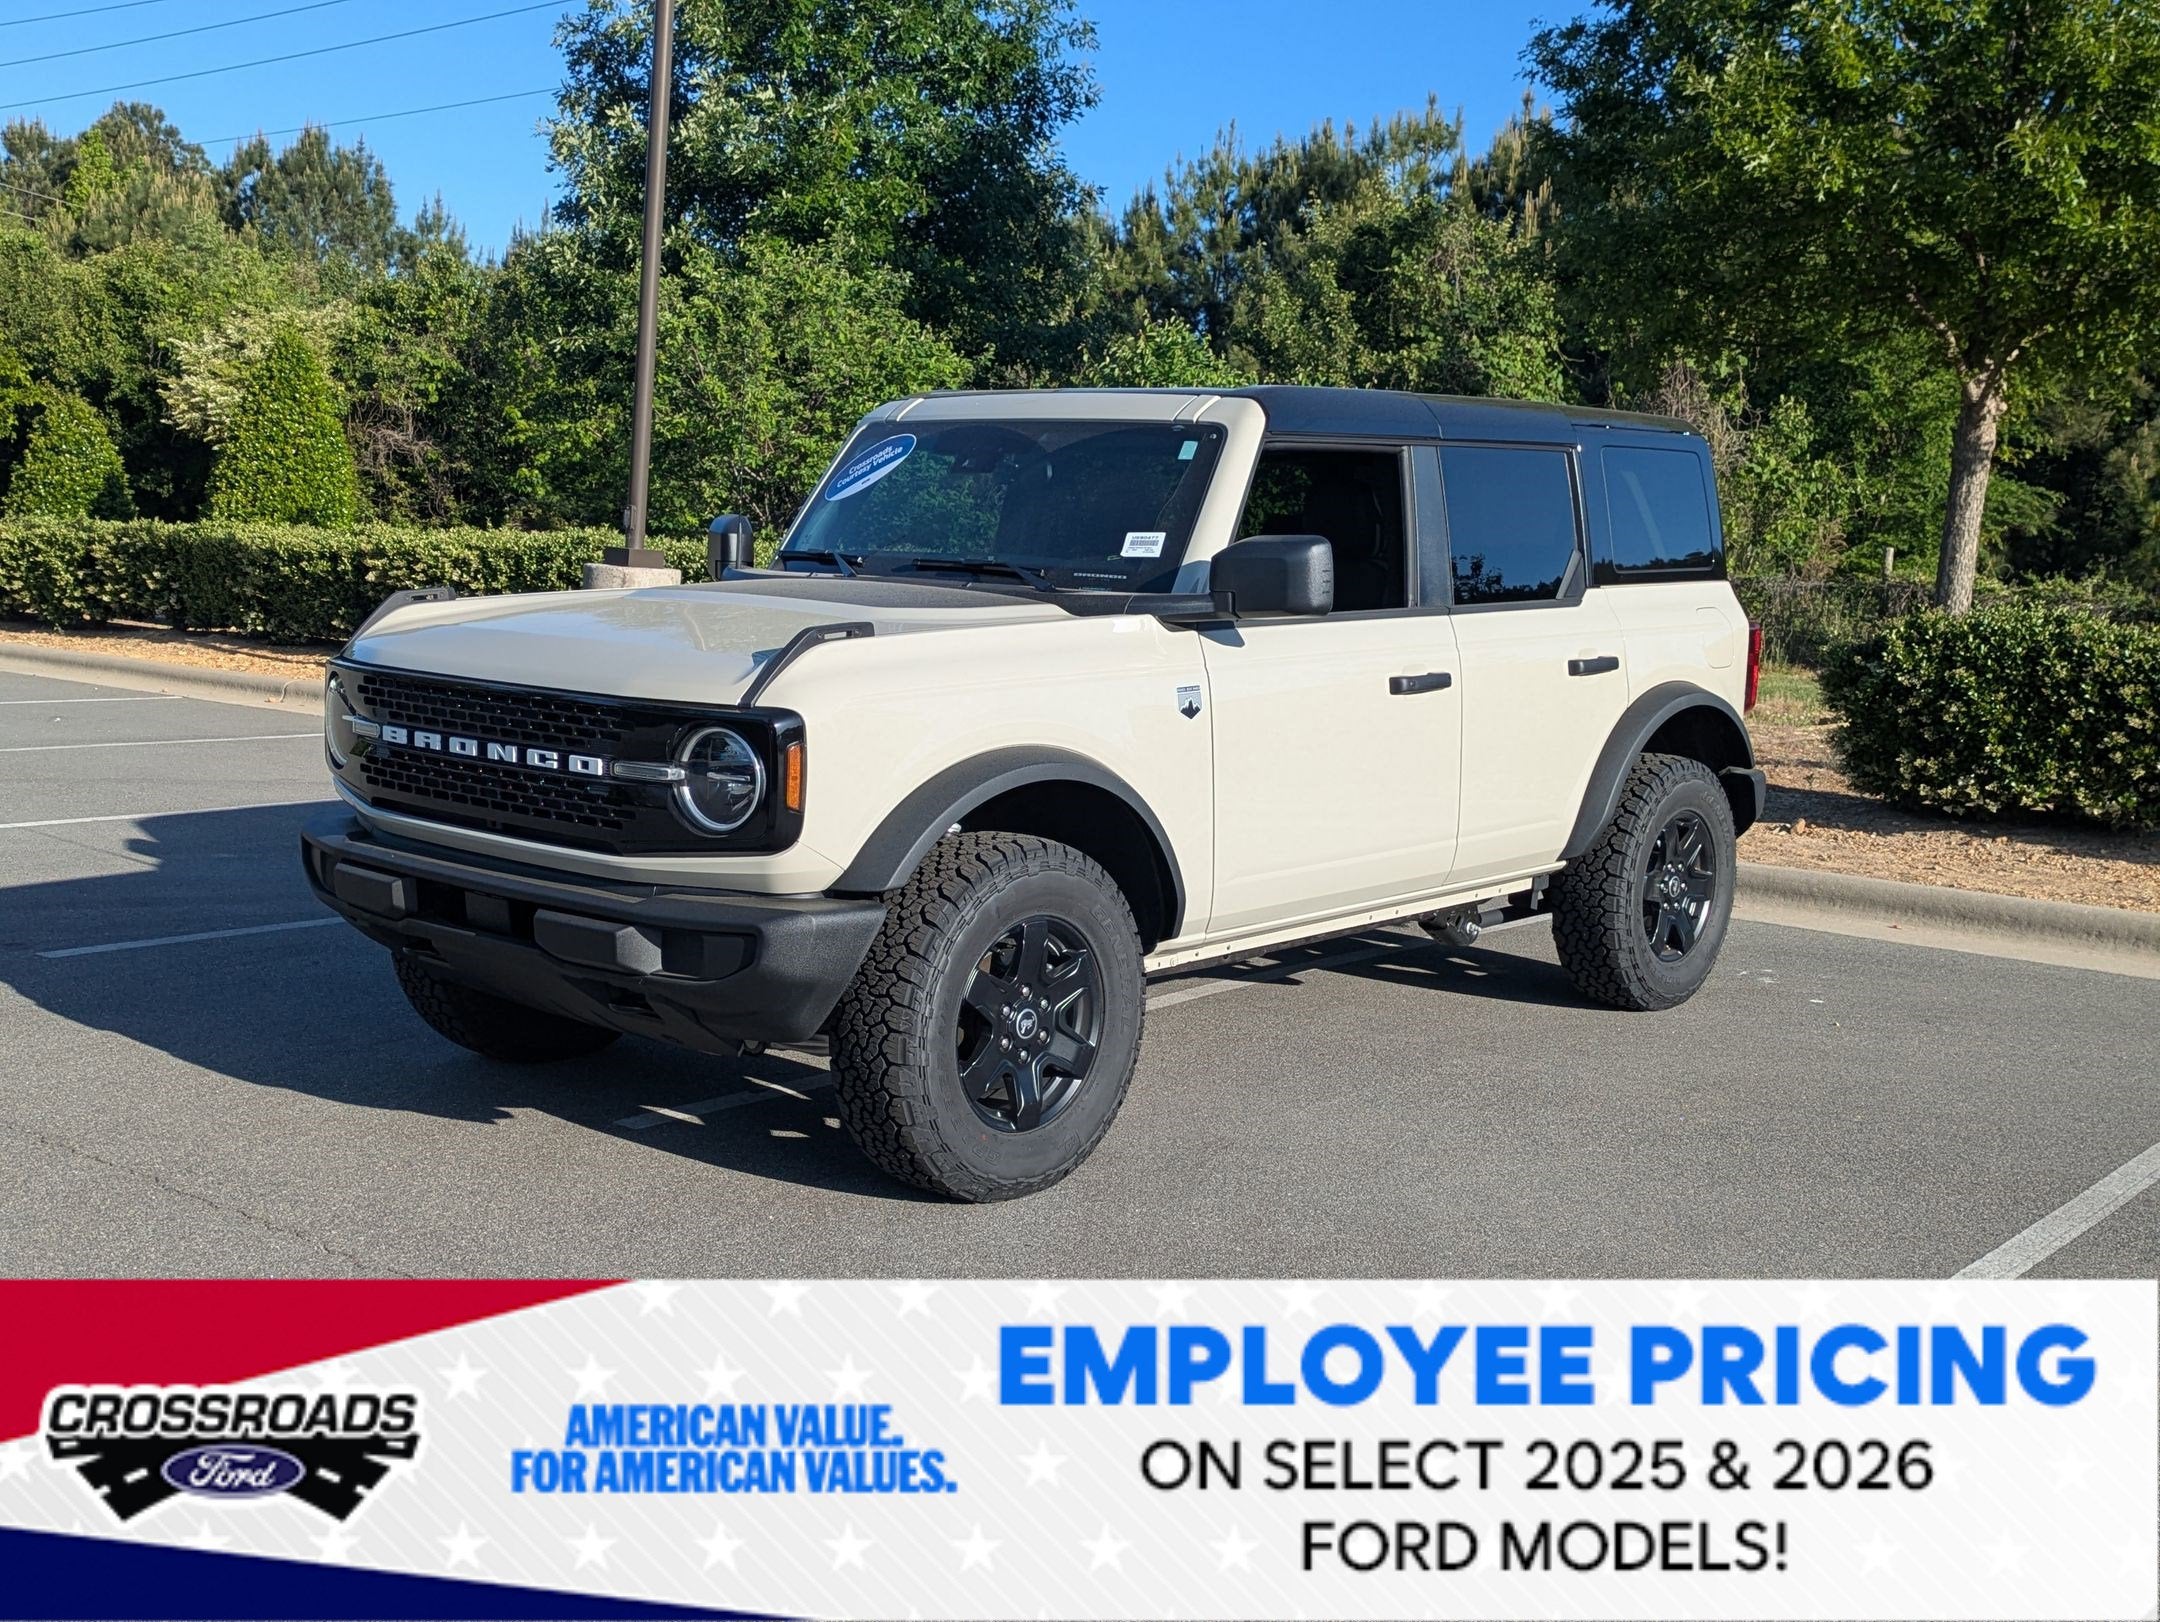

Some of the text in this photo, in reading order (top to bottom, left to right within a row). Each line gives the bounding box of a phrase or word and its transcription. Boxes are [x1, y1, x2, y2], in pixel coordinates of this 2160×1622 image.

[837, 446, 903, 487] Courtesy Vehicle
[849, 445, 893, 475] Crossroads
[382, 725, 603, 776] BRONCO
